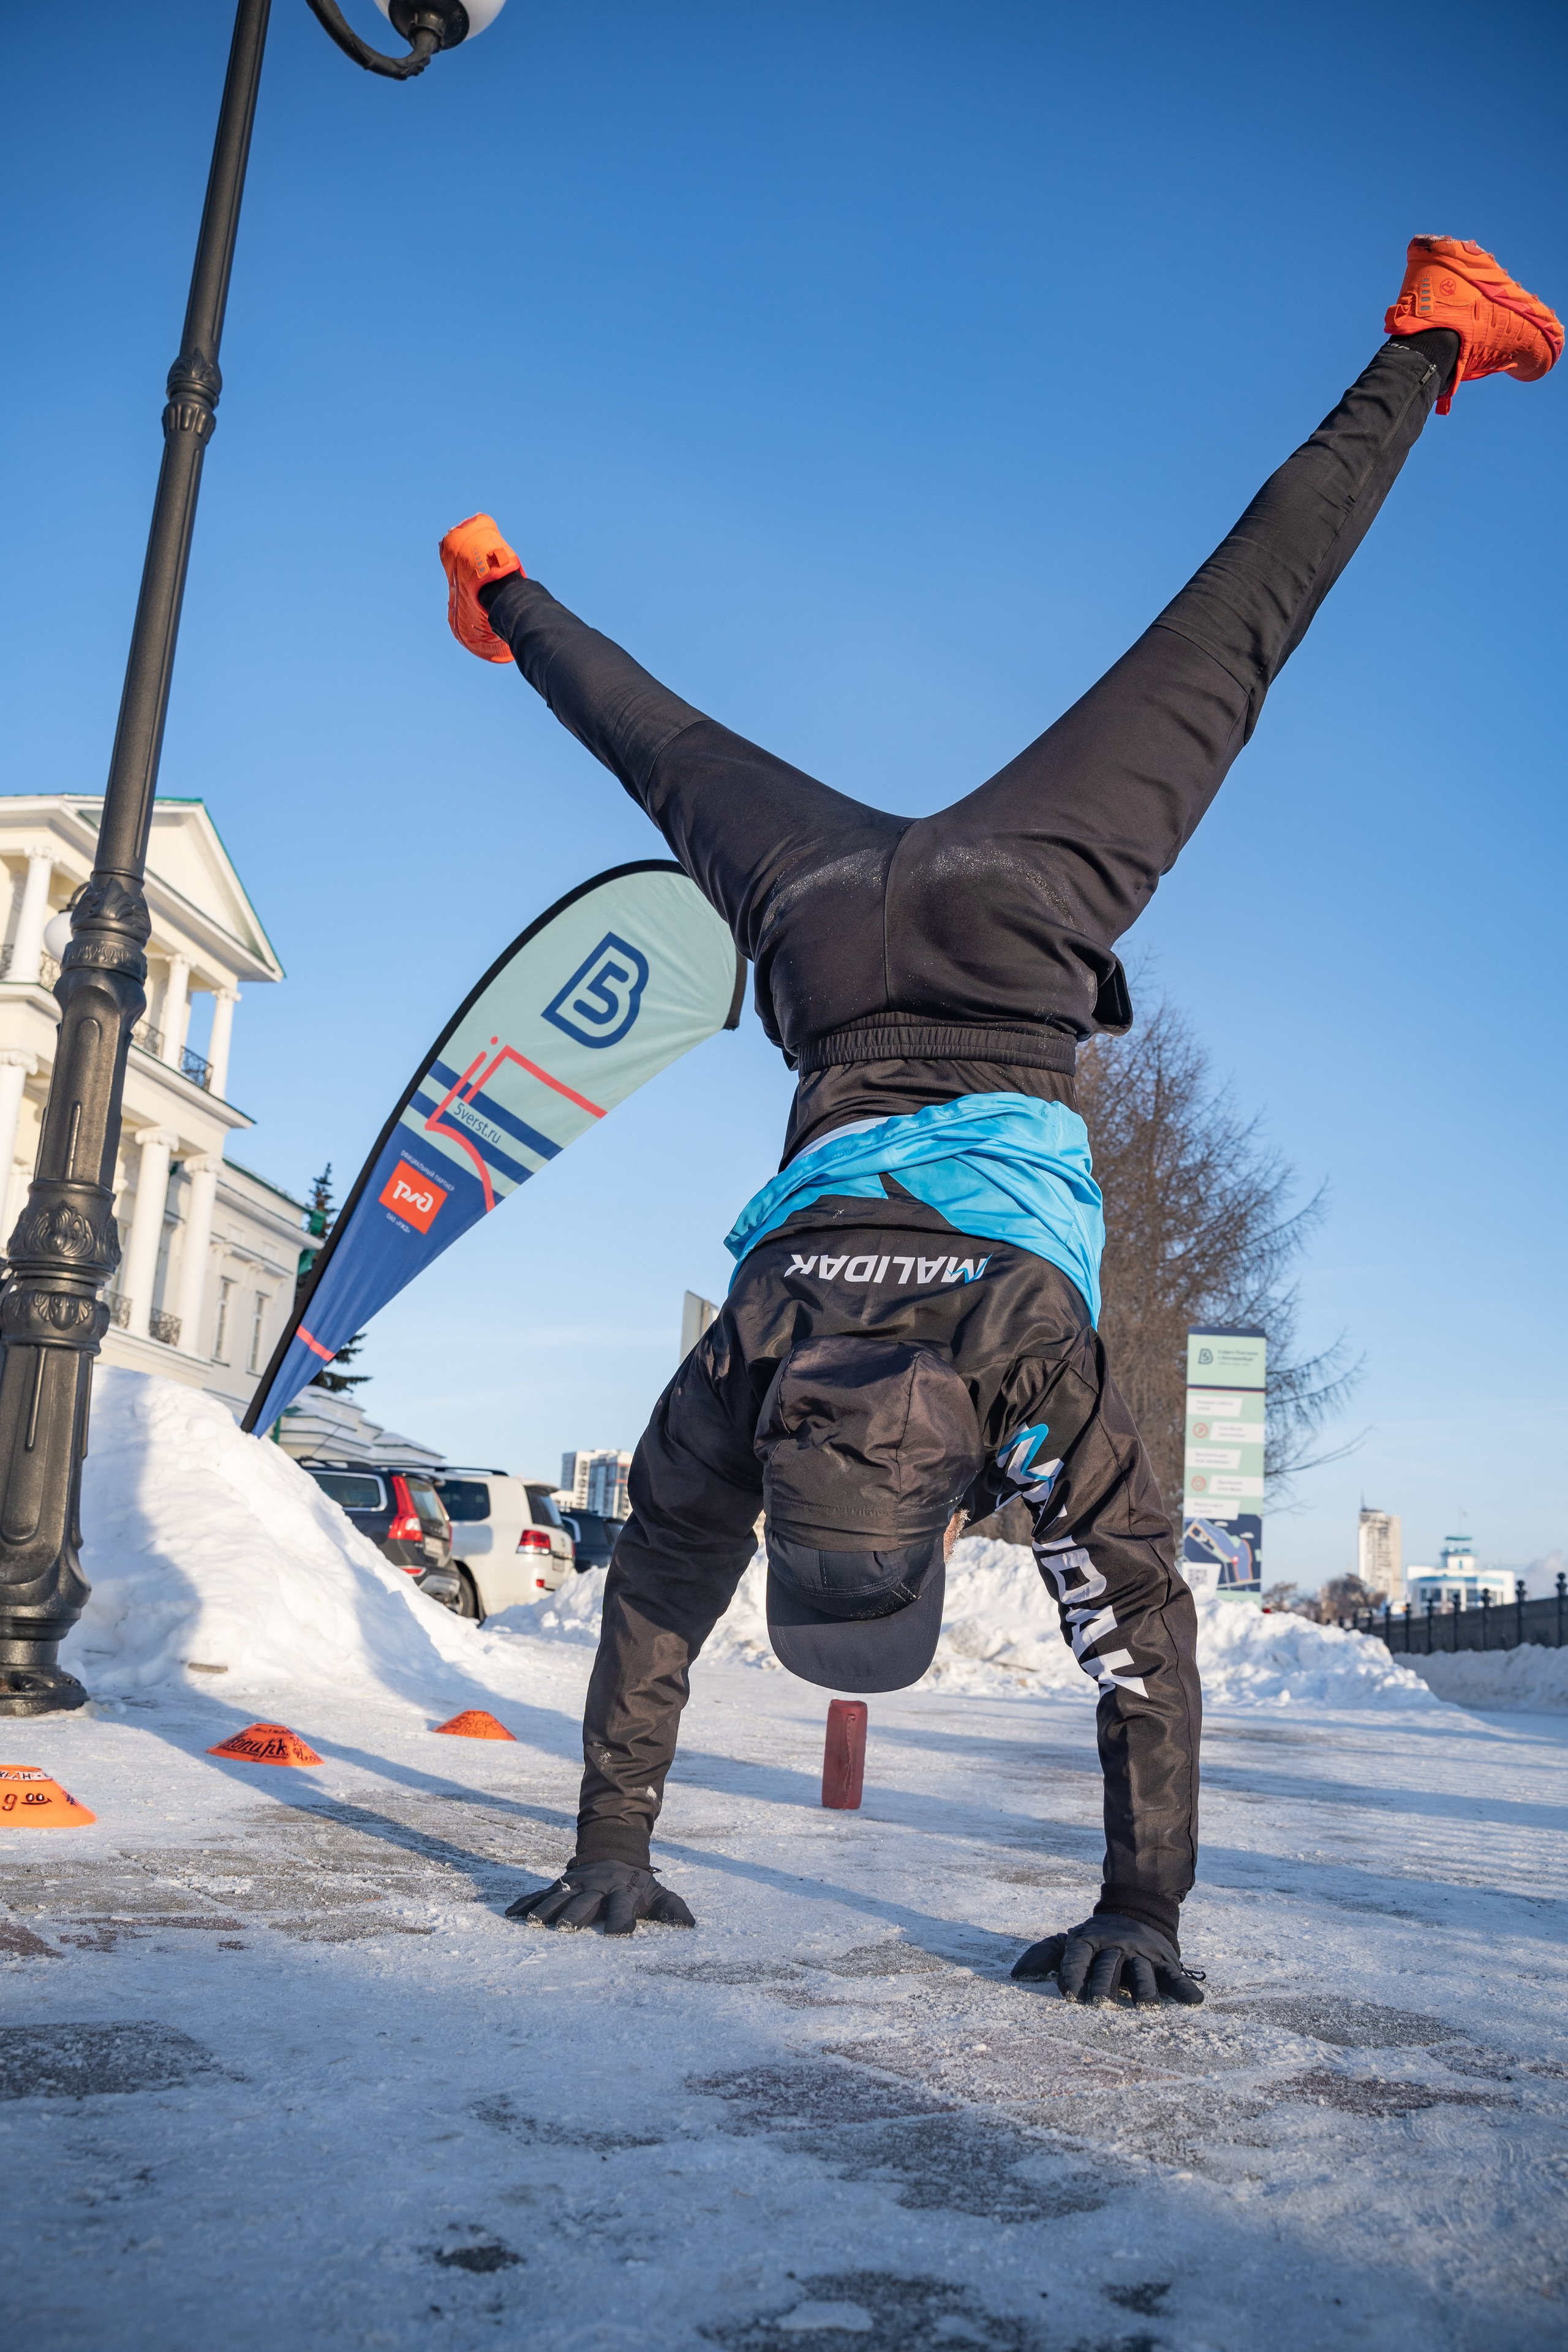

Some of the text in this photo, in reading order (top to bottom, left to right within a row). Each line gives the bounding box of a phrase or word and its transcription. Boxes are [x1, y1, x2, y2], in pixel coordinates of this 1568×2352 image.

[454, 1102, 501, 1144] 5verst.ru
[400, 1150, 455, 1191] ОФИЦИАЛЬНЫЙ ПАРТНЕР
[386, 1212, 396, 1223] ОАО
[784, 1252, 993, 1284] MALIDAK
